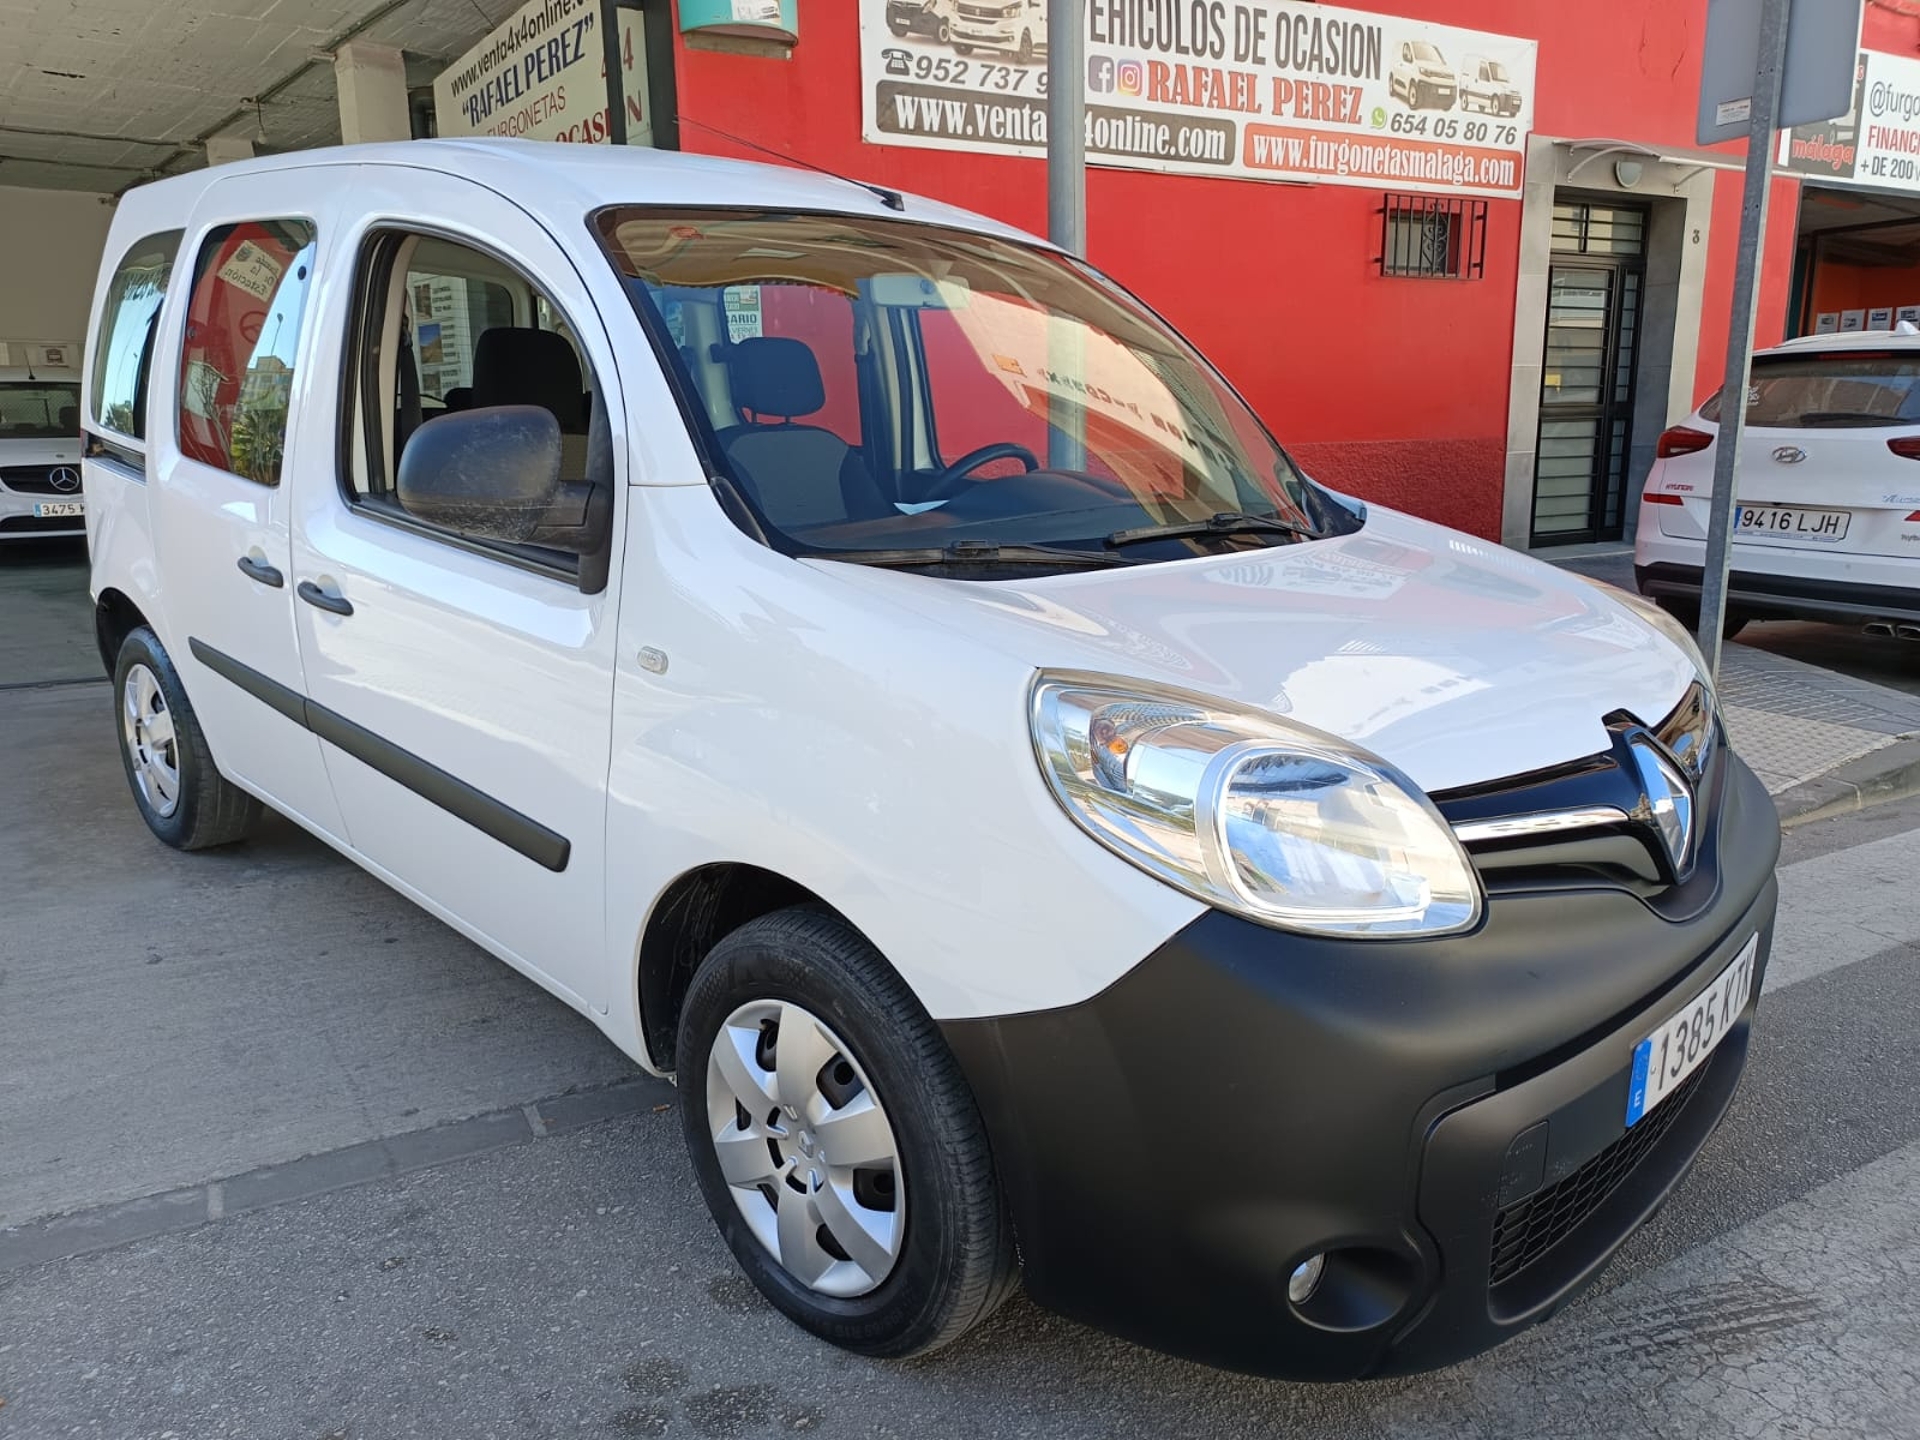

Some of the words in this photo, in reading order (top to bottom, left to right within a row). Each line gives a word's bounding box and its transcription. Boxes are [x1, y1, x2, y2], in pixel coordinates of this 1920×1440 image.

[451, 0, 590, 97] www.venta4x4online.
[1083, 0, 1226, 60] EHICULOS
[1234, 5, 1268, 65] DE
[1275, 11, 1382, 80] OCASION
[914, 55, 969, 84] 952
[980, 64, 1028, 92] 737
[1147, 59, 1261, 114] RAFAEL
[1271, 76, 1363, 125] PEREZ
[894, 94, 1226, 161] www.venta4online.com
[1390, 112, 1428, 135] 654
[1434, 117, 1457, 139] 05
[1464, 121, 1488, 142] 80
[1496, 124, 1518, 145] 76
[1252, 133, 1515, 186] www.furgonetasmalaga.com
[1871, 155, 1888, 177] DE
[1889, 158, 1914, 180] 200
[42, 504, 76, 516] 3475
[1741, 509, 1793, 530] 9416
[1797, 513, 1841, 535] LJH
[1658, 992, 1717, 1091] 1385
